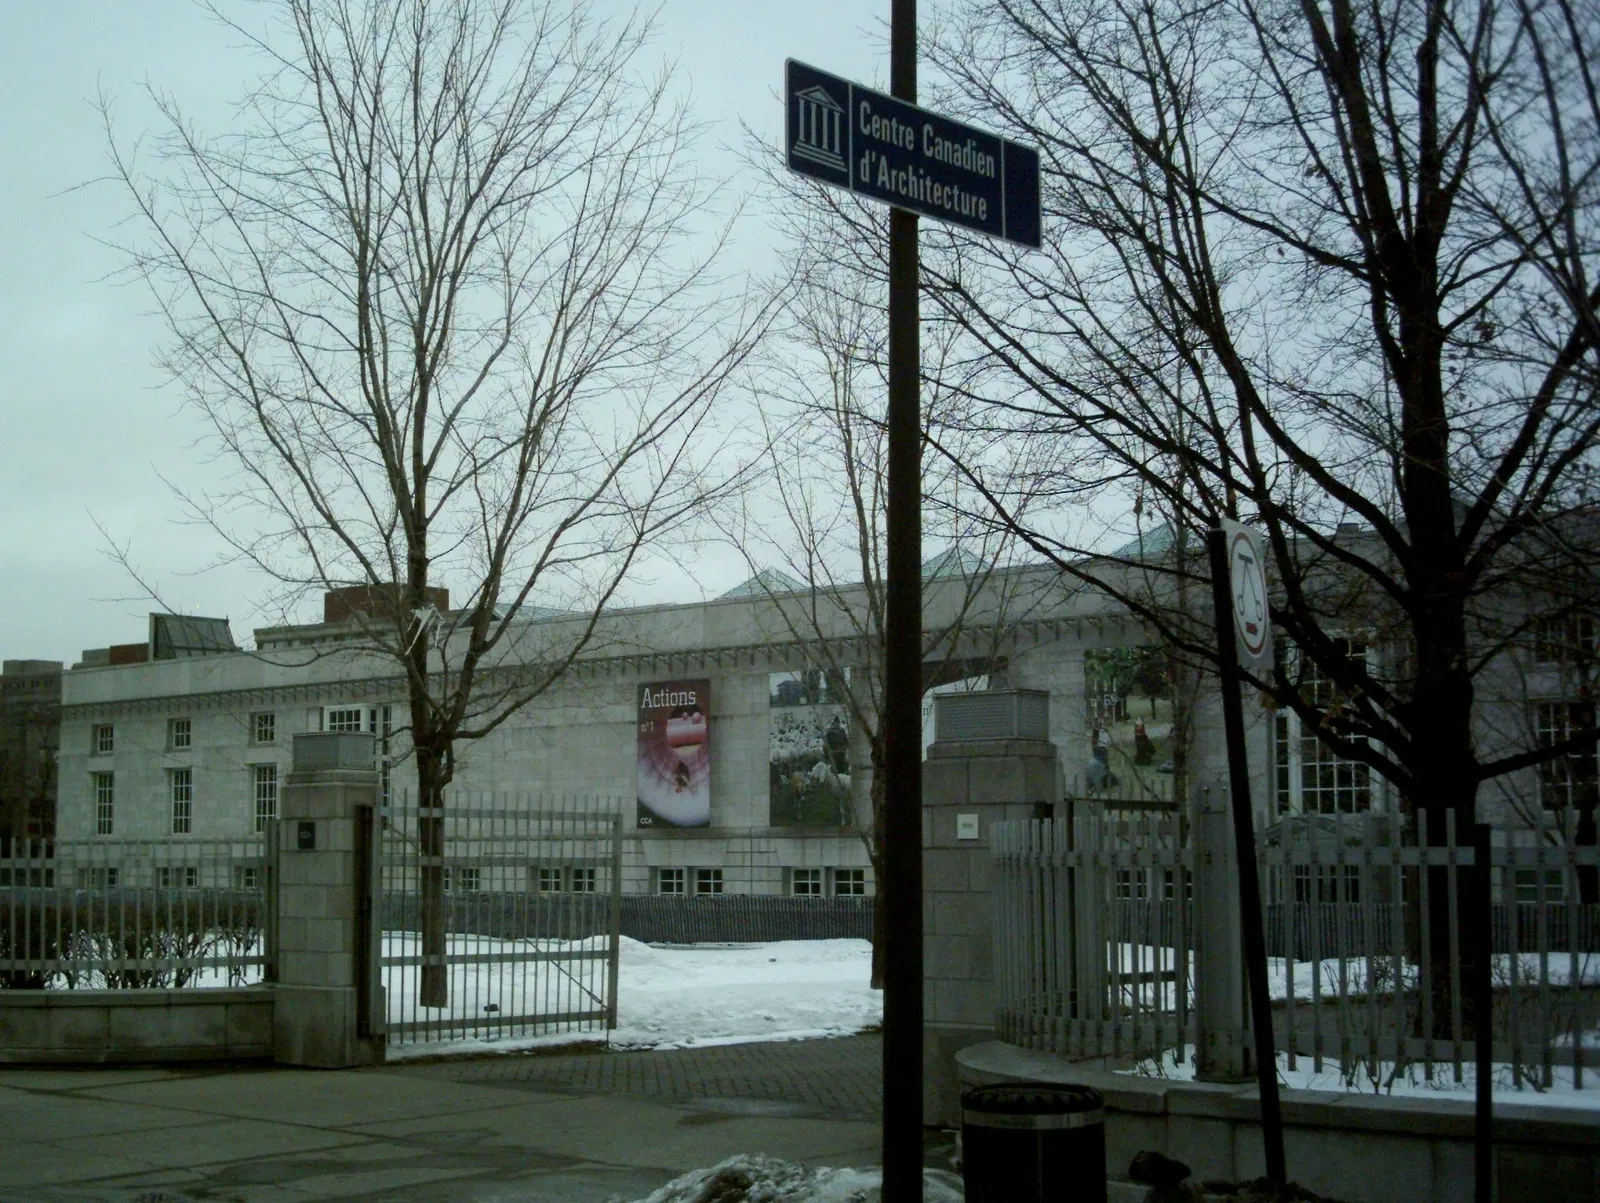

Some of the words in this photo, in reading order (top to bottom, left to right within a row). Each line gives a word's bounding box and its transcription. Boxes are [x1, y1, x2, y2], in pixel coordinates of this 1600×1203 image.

[860, 101, 914, 151] Centre
[922, 123, 995, 179] Canadien
[860, 150, 987, 221] d'Architecture
[640, 687, 697, 709] Actions
[640, 817, 653, 825] CCA
